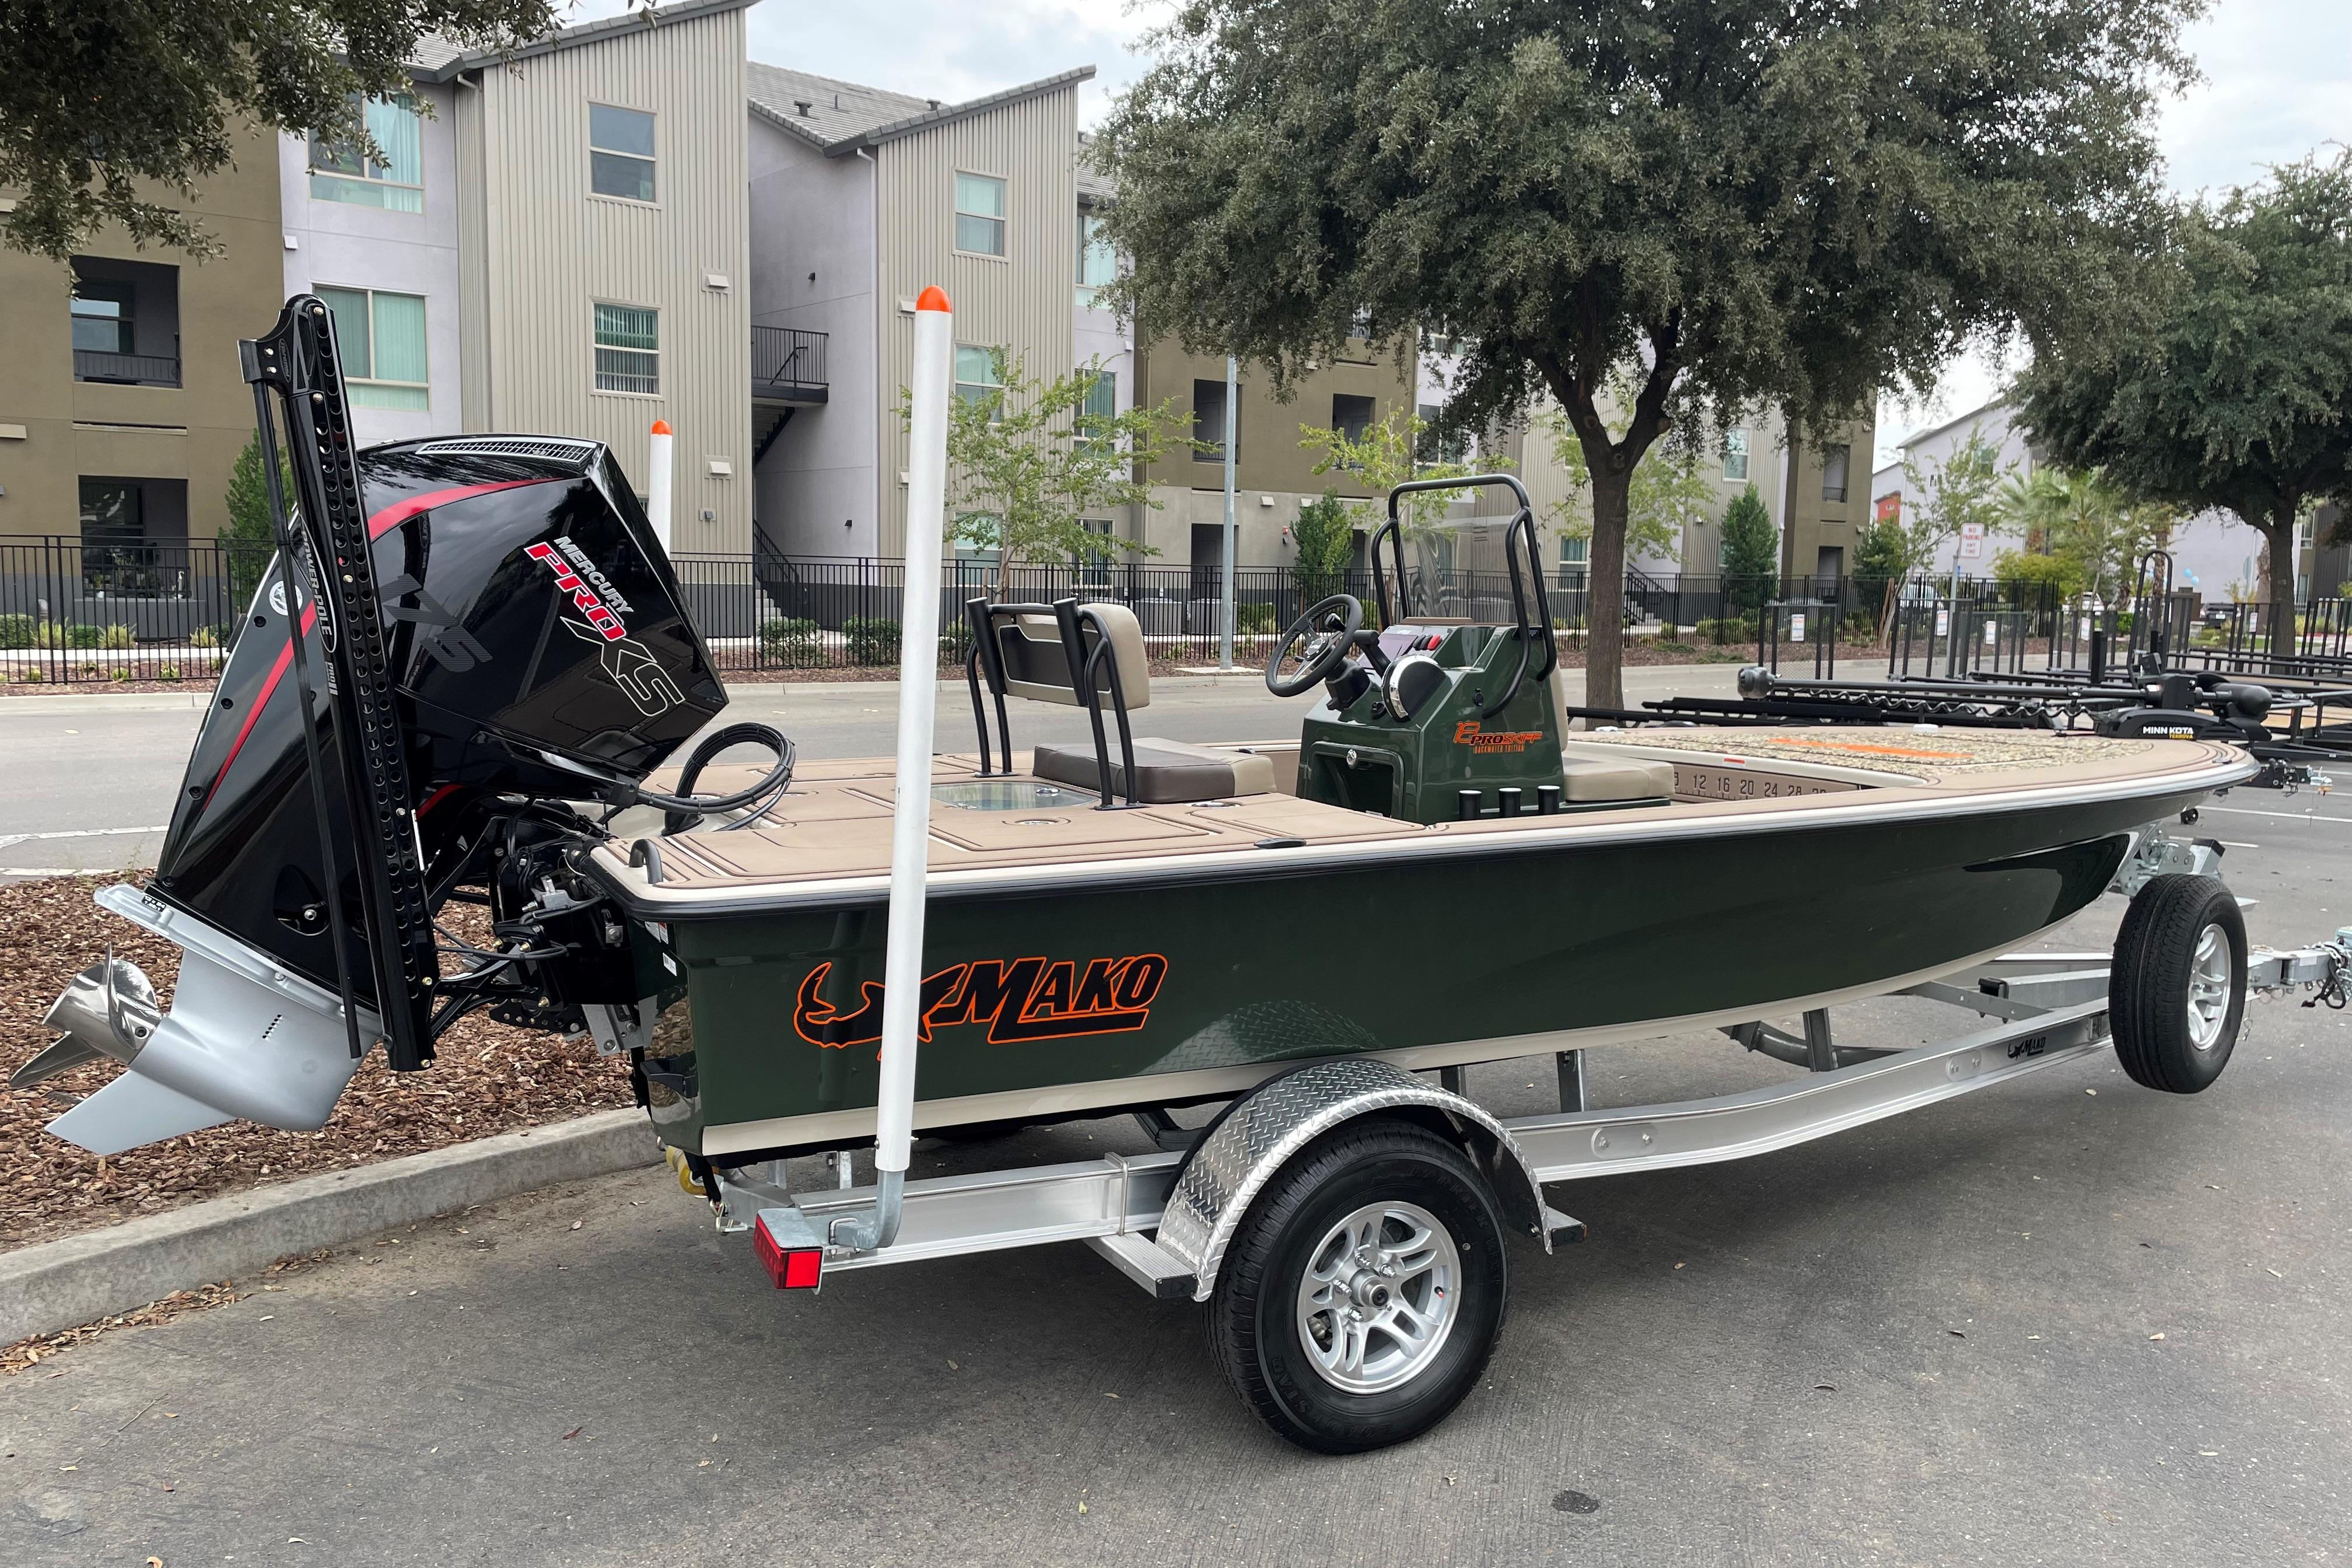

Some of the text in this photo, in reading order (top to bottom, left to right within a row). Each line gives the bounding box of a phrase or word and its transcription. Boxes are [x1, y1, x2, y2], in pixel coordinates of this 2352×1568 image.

[301, 530, 332, 636] POWER-POLE
[524, 541, 626, 642] PRO
[554, 536, 634, 612] MERCURY
[559, 616, 686, 717] XS
[2143, 726, 2193, 734] MINN KOTA
[1693, 774, 1707, 790] 12
[1717, 777, 1730, 793] 16
[1740, 779, 1754, 796] 20
[1764, 782, 1778, 798] 24
[952, 953, 1168, 1044] MAKO
[2021, 1037, 2046, 1057] MAKO
